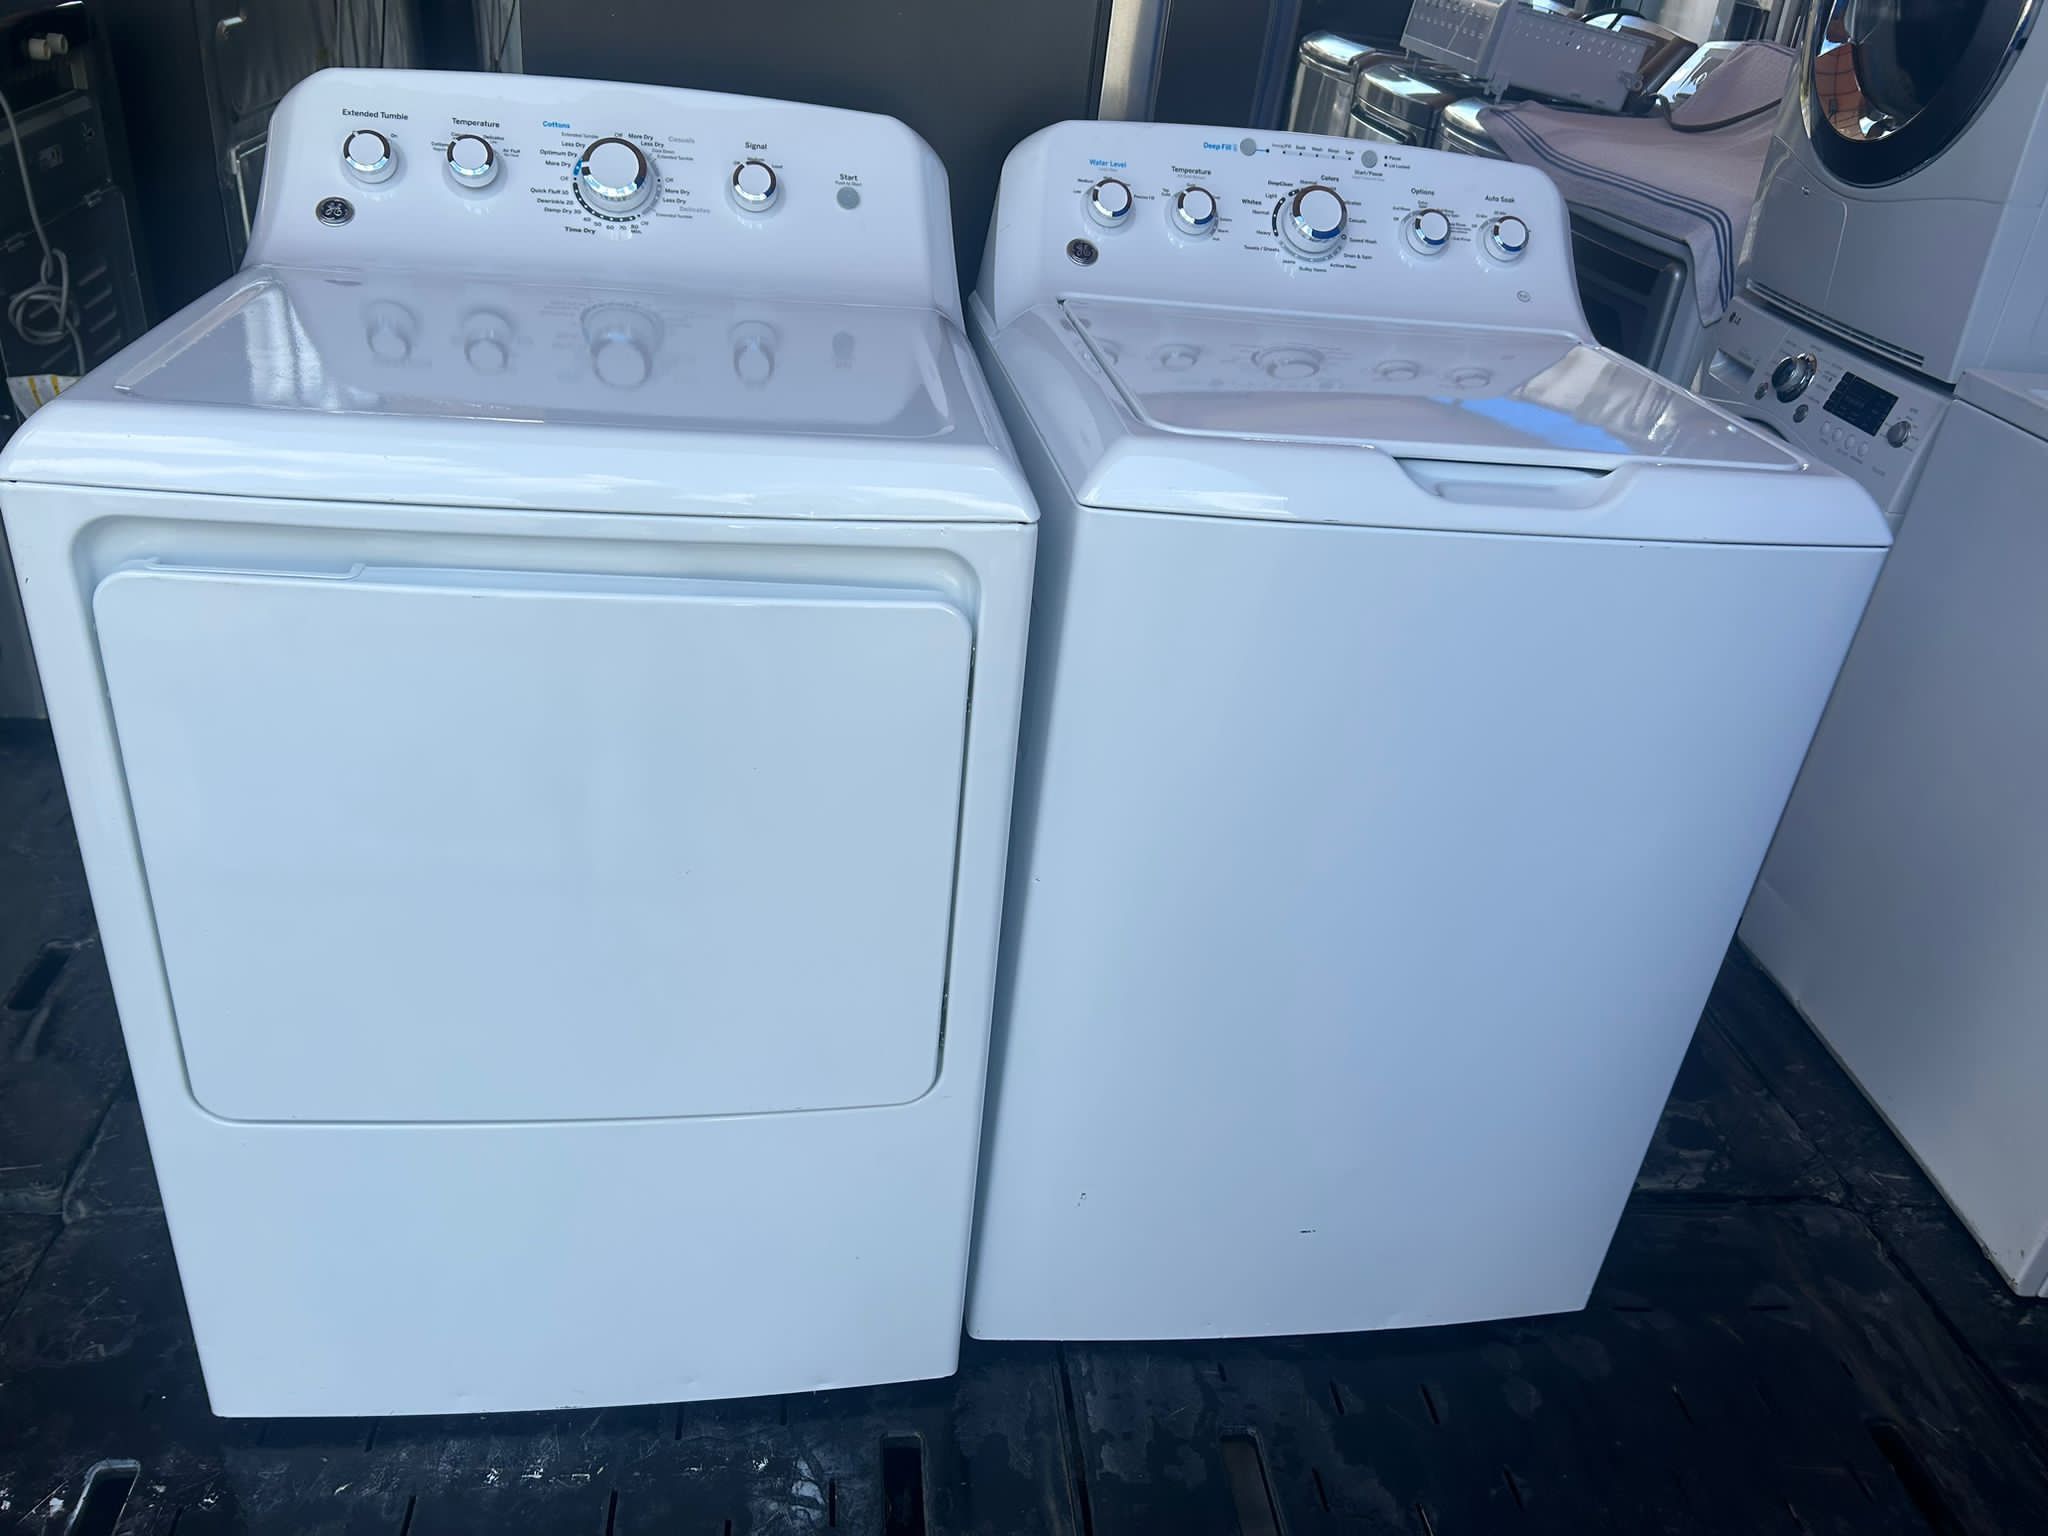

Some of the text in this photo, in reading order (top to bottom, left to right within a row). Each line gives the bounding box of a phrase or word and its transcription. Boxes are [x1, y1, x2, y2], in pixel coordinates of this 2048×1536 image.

[342, 108, 409, 121] Extended Tumble
[452, 117, 500, 128] Temperature
[543, 121, 570, 129] Cottons
[745, 141, 768, 150] Signal
[1203, 141, 1221, 150] Deep
[1088, 159, 1127, 168] Water Level
[1172, 165, 1211, 175] Temperature
[839, 173, 858, 181] Start
[1411, 187, 1434, 196] Options
[583, 227, 596, 235] Dry
